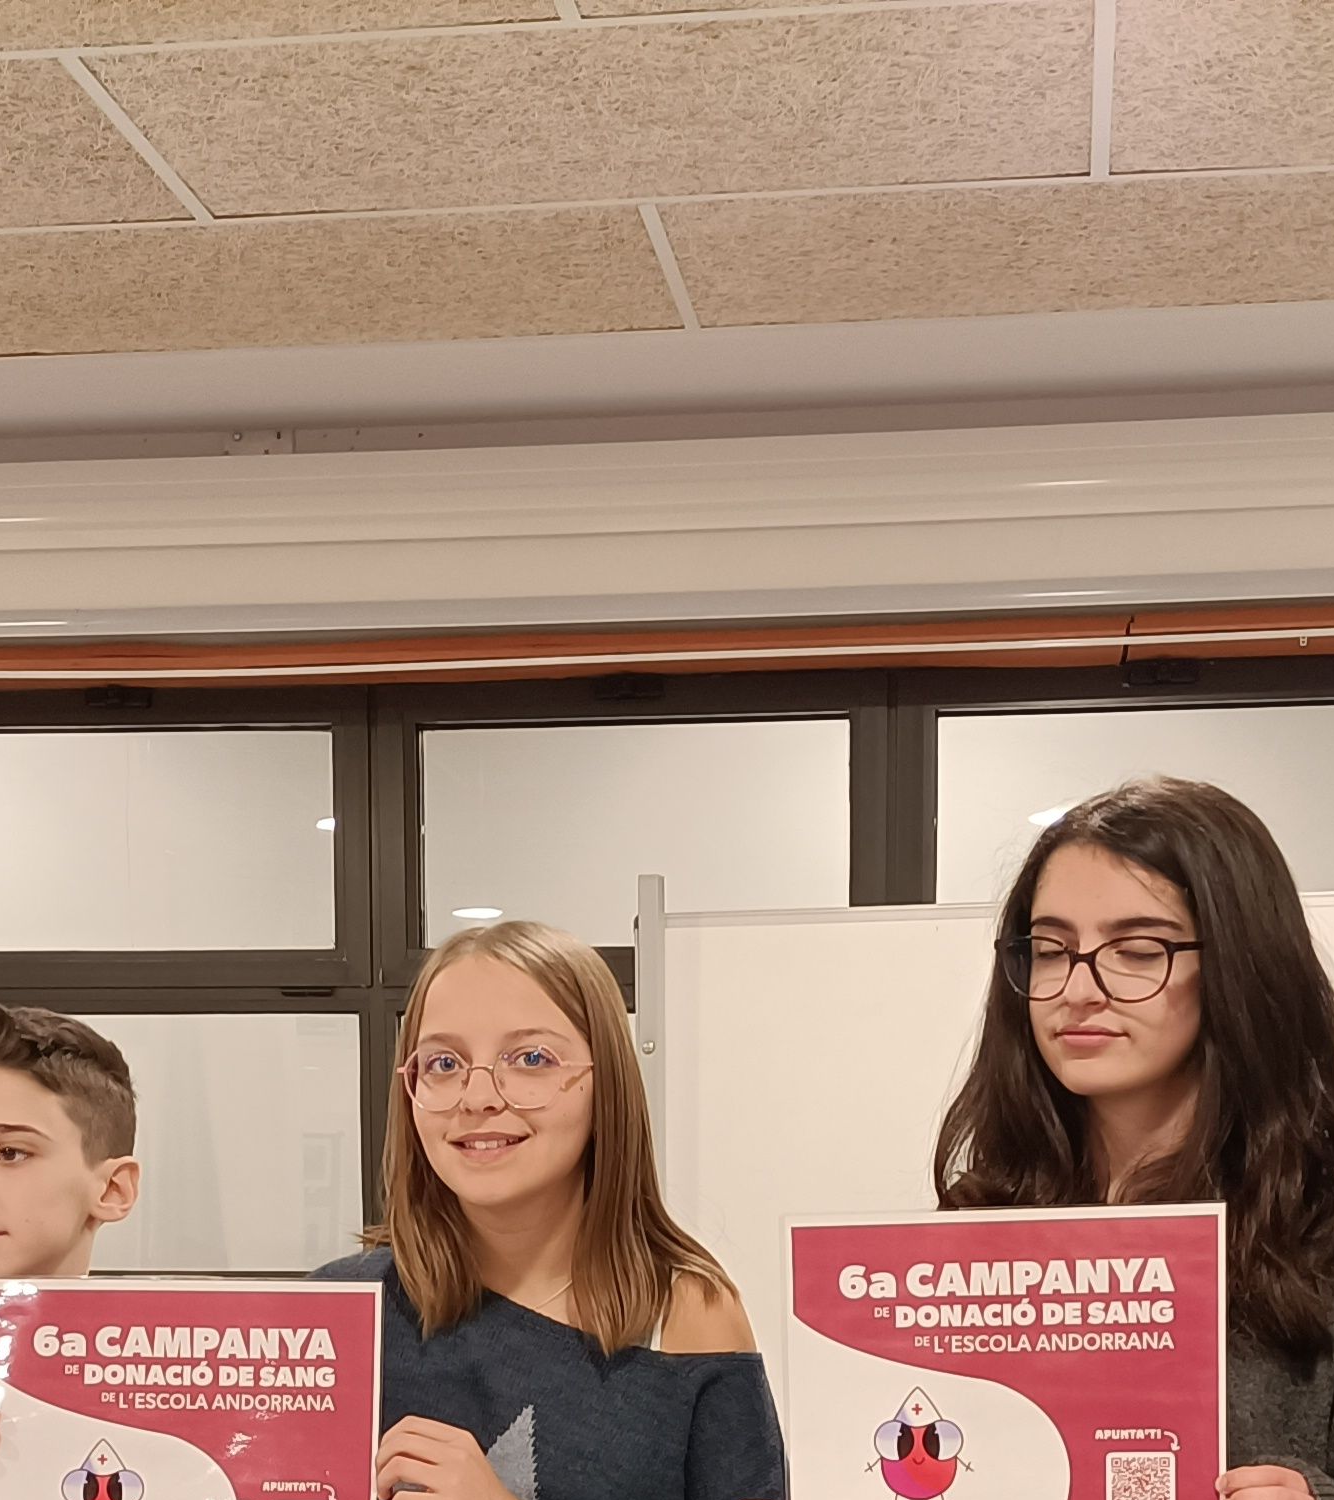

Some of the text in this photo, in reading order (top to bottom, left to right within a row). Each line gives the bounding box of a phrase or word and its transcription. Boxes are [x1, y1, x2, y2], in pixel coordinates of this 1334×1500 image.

[838, 1257, 1175, 1299] 6a CAMPANYA
[874, 1299, 1174, 1328] DE DONACIÓ DE SANG
[33, 1326, 337, 1360] 6a CAMPANYA
[914, 1331, 1174, 1353] DE L'ESCOLA ANDORRANA
[64, 1361, 335, 1388] DE DONACIÓ DE SANG
[101, 1393, 334, 1411] DE L'ESCOLA ANDORRANA
